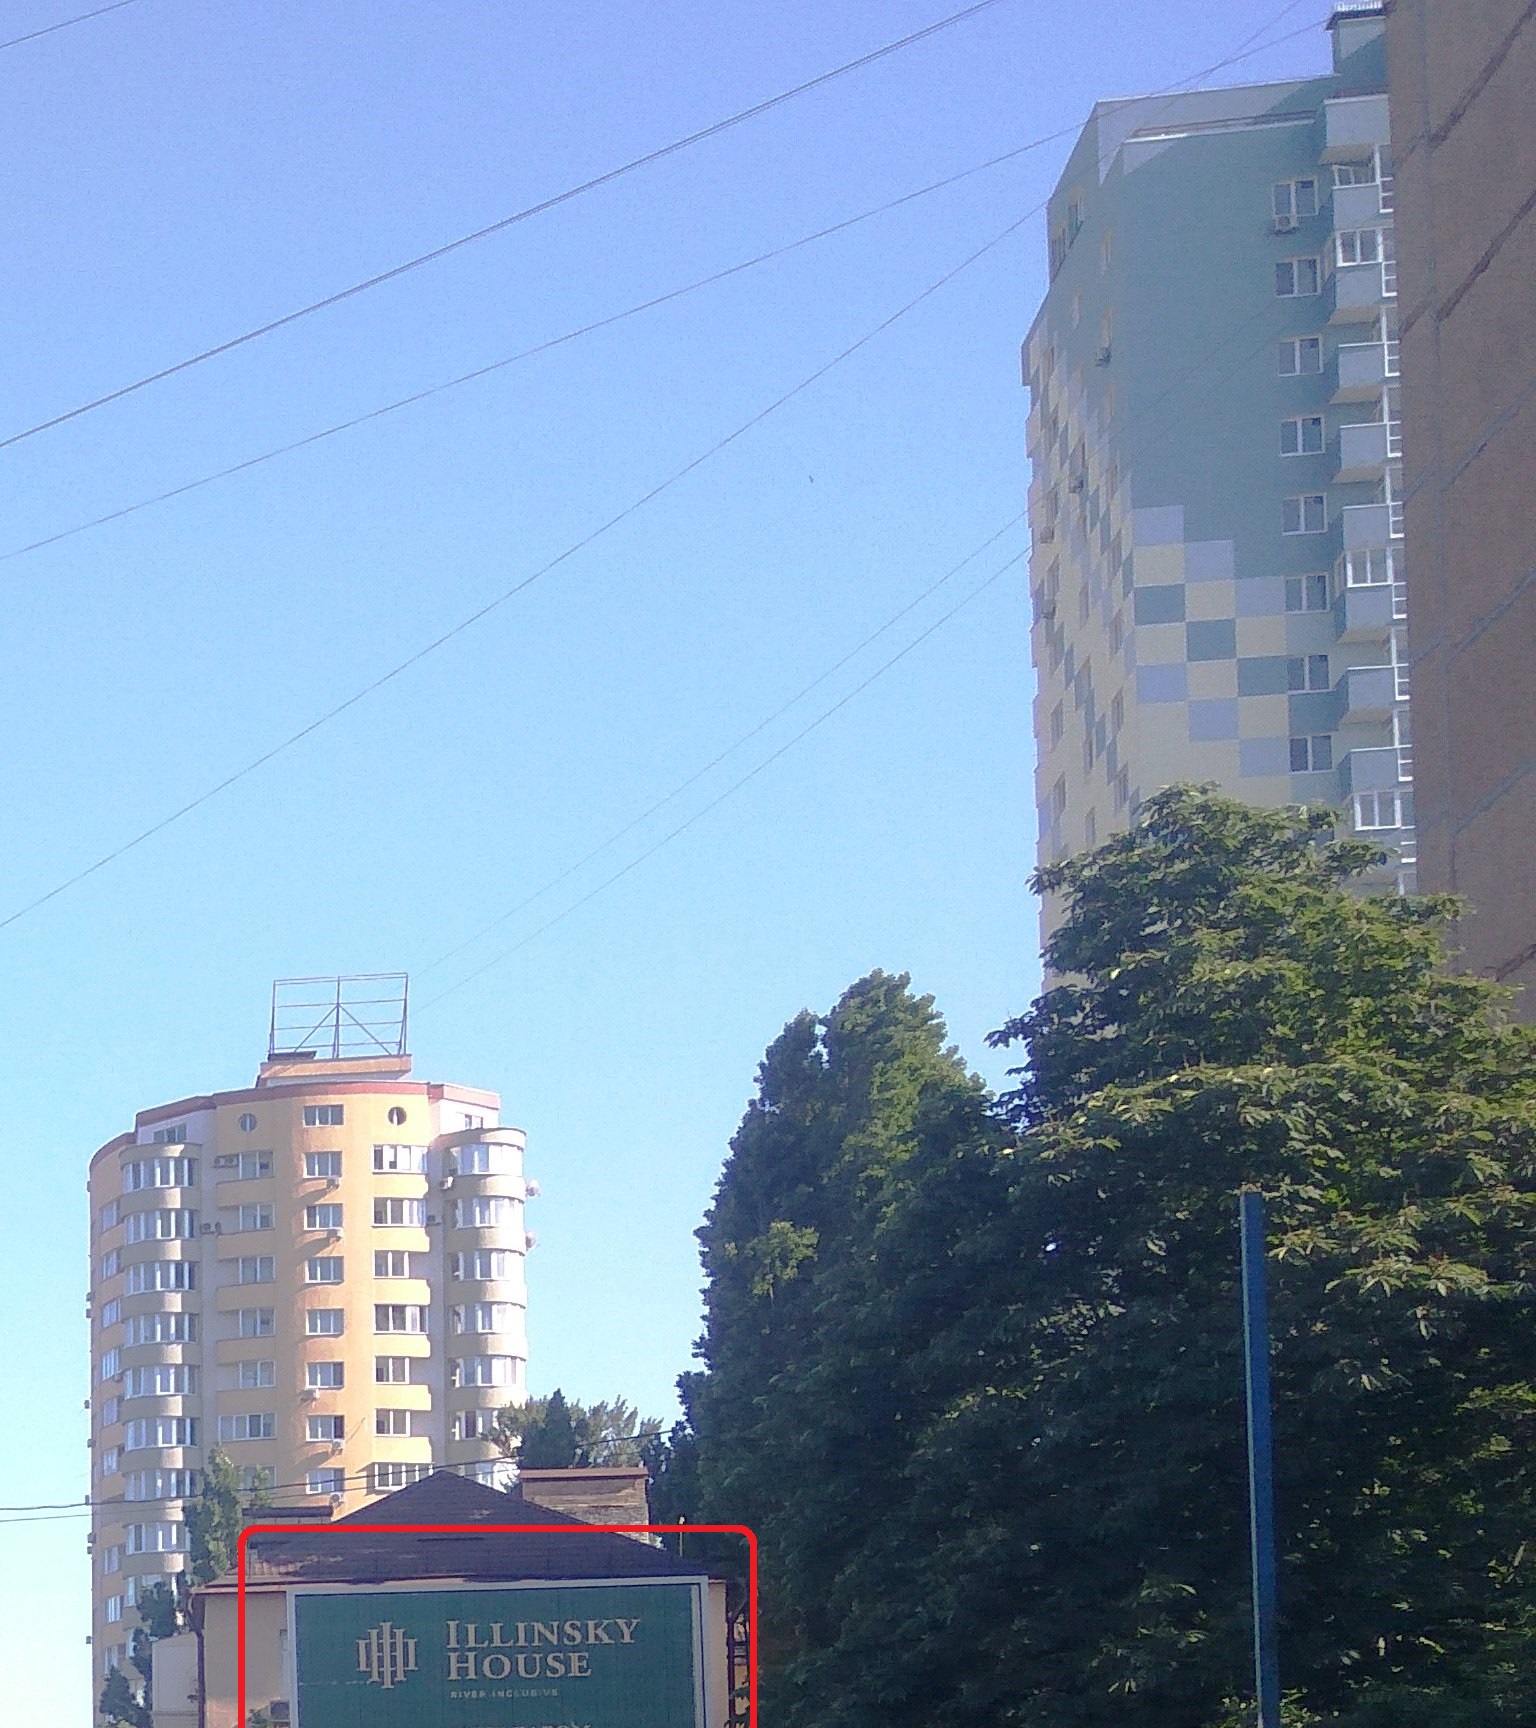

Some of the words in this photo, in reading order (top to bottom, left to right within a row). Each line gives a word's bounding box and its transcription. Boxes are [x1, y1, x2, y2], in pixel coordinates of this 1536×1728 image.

[446, 1618, 640, 1648] ILLINSKY
[447, 1651, 592, 1680] HOUSE
[450, 1690, 486, 1699] RIVER
[492, 1688, 560, 1698] INCUSVE
